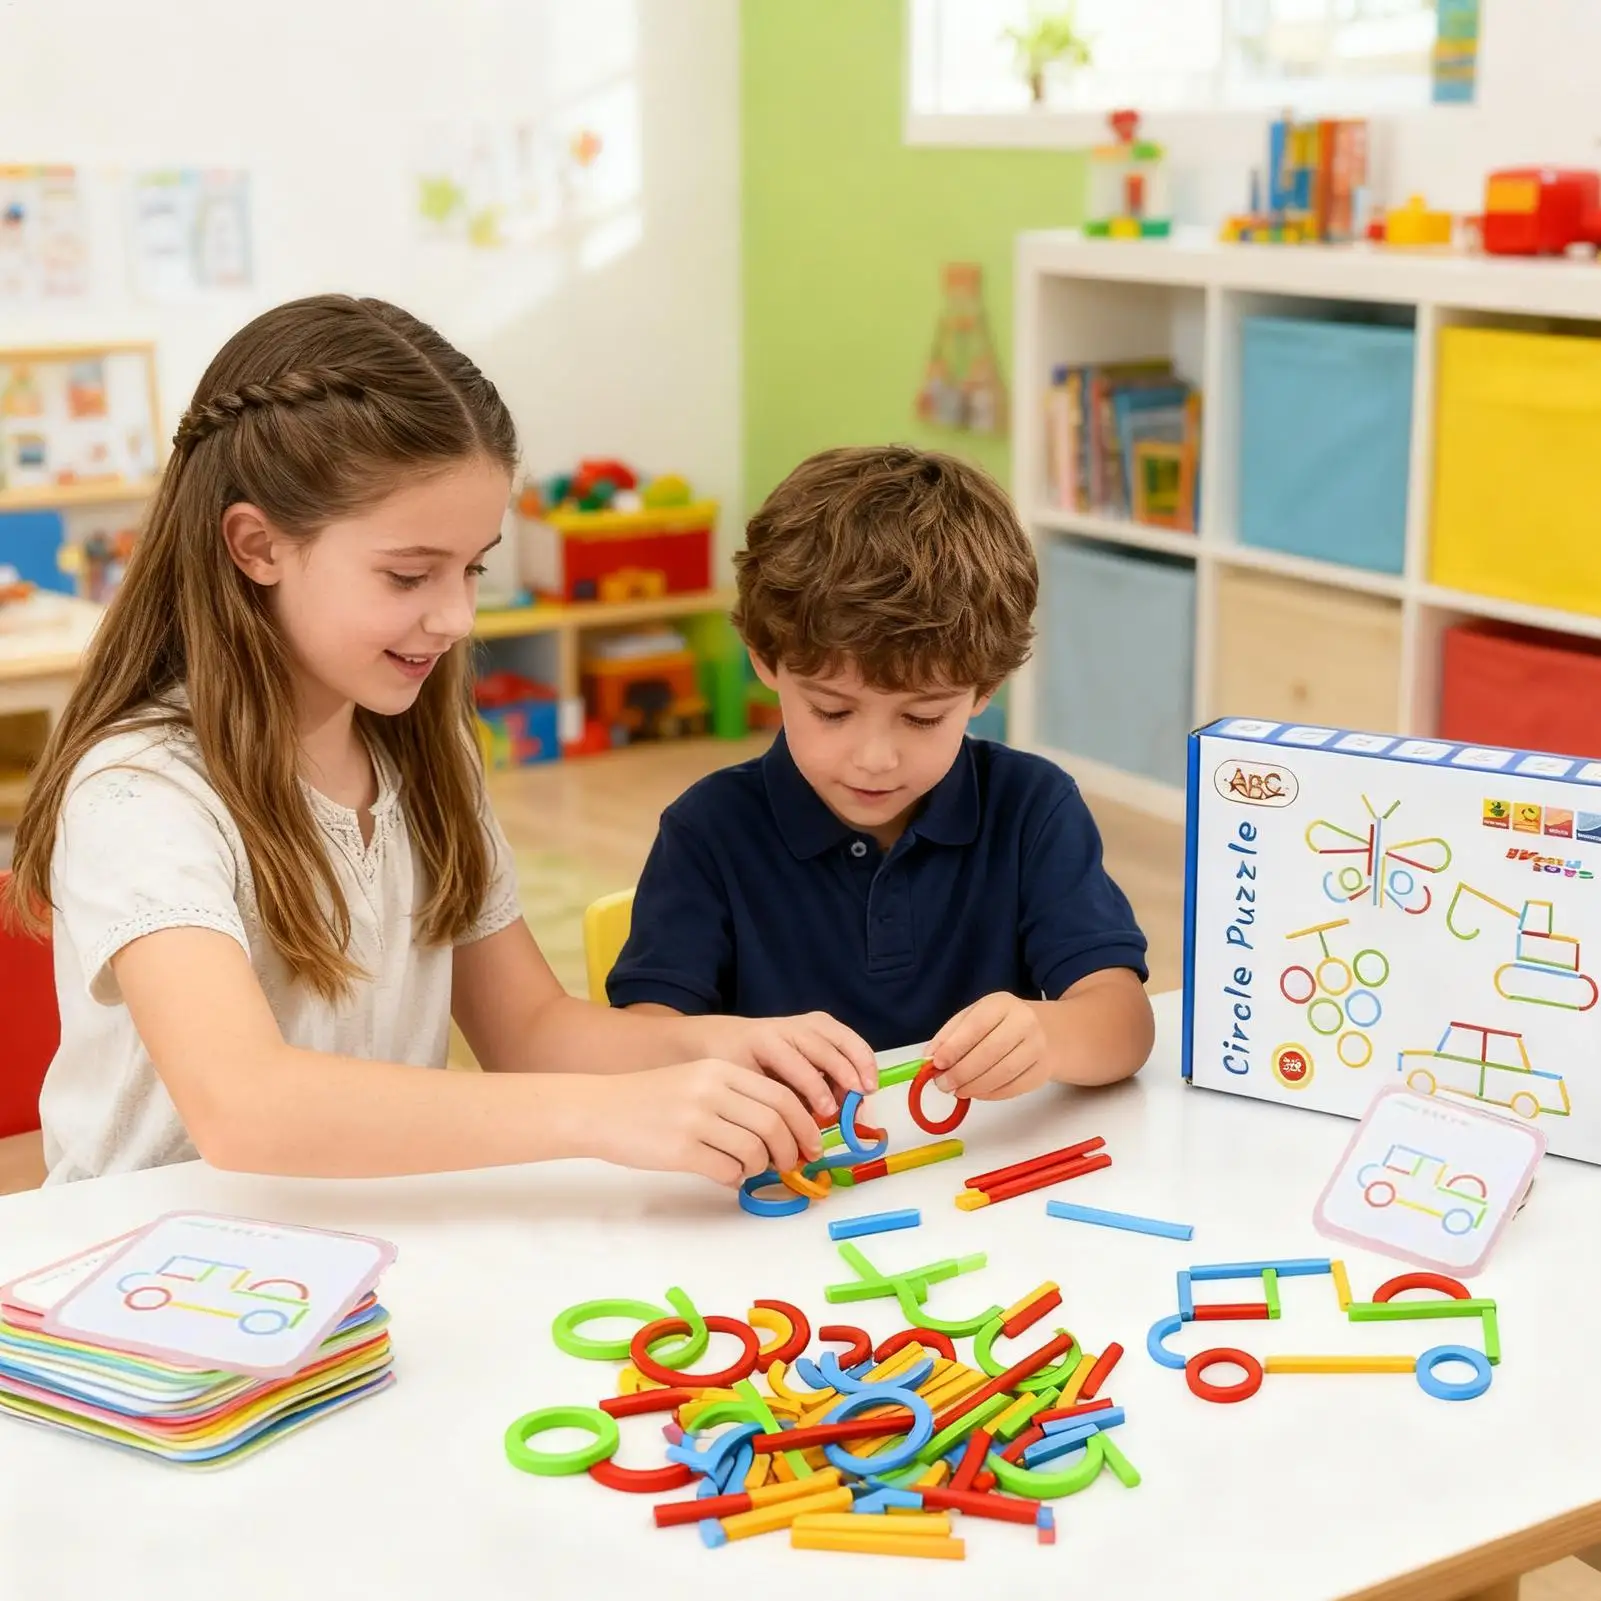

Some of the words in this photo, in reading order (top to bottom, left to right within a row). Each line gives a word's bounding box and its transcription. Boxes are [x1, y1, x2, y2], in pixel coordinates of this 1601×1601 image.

[1229, 768, 1286, 800] ABC
[1226, 821, 1258, 950] Puzzle
[1222, 966, 1253, 1075] Circle
